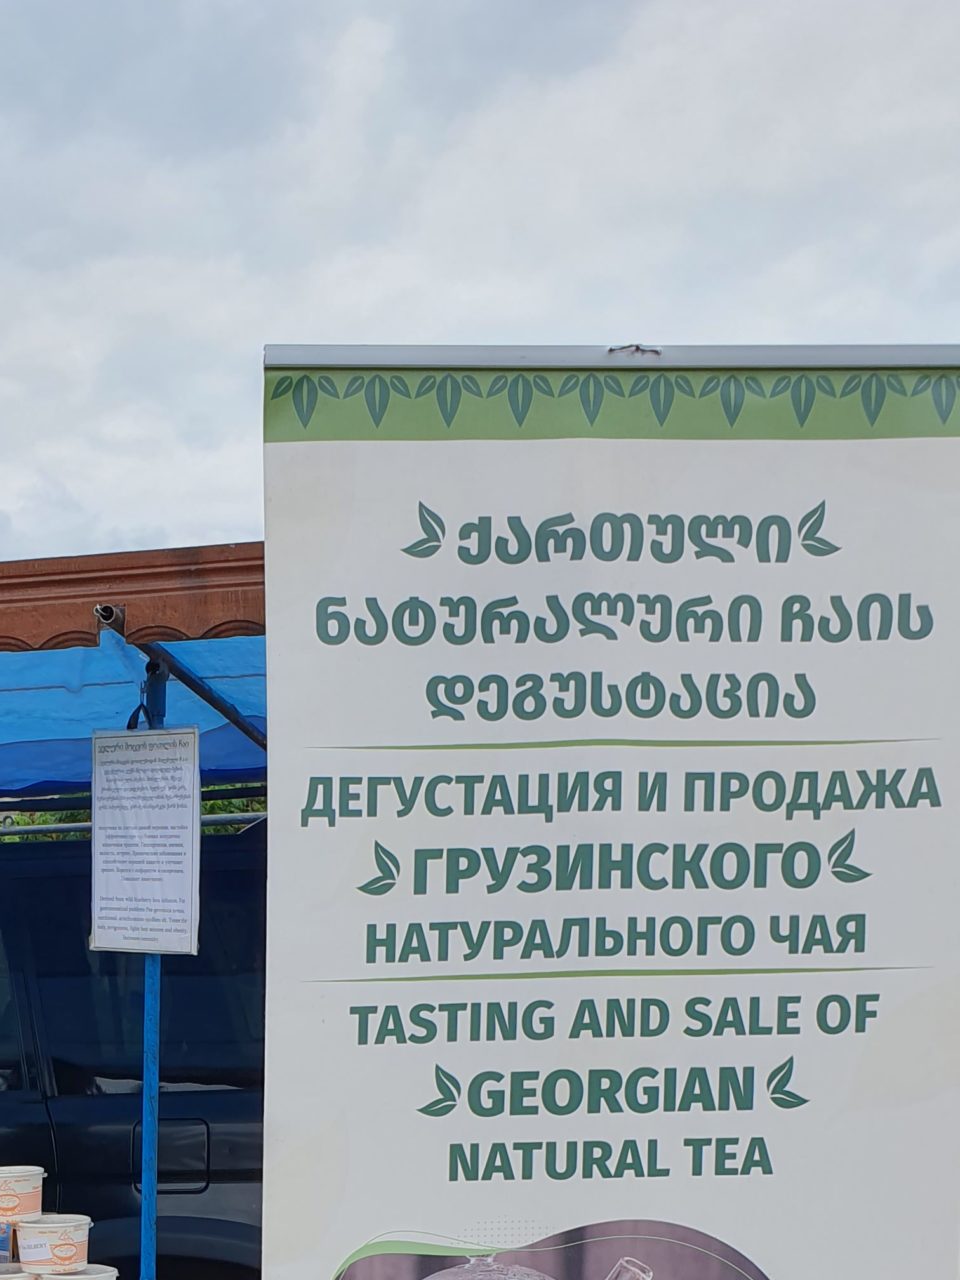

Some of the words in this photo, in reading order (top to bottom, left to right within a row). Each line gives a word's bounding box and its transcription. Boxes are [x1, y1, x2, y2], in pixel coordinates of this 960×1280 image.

[457, 512, 792, 565] ქართული
[315, 591, 763, 646] ნატურალური
[780, 593, 935, 643] ჩაის
[425, 671, 817, 722] დეგუსტაცია
[300, 770, 623, 828] ДЕГУСТАЦИЯ
[638, 771, 668, 814] И
[683, 767, 943, 821] ПРОДАЖА
[411, 841, 823, 895] ГРУЗИНСКОГО
[365, 914, 756, 964] НАТУРАЛЬНОГО
[769, 913, 867, 955] ЧАЯ
[349, 999, 556, 1046] TASTING
[568, 998, 671, 1039] AND
[683, 995, 802, 1038] SALE
[816, 993, 881, 1035] OF
[467, 1066, 756, 1118] GEORGIAN
[448, 1139, 671, 1182] NATURAL
[683, 1136, 774, 1177] TEA
